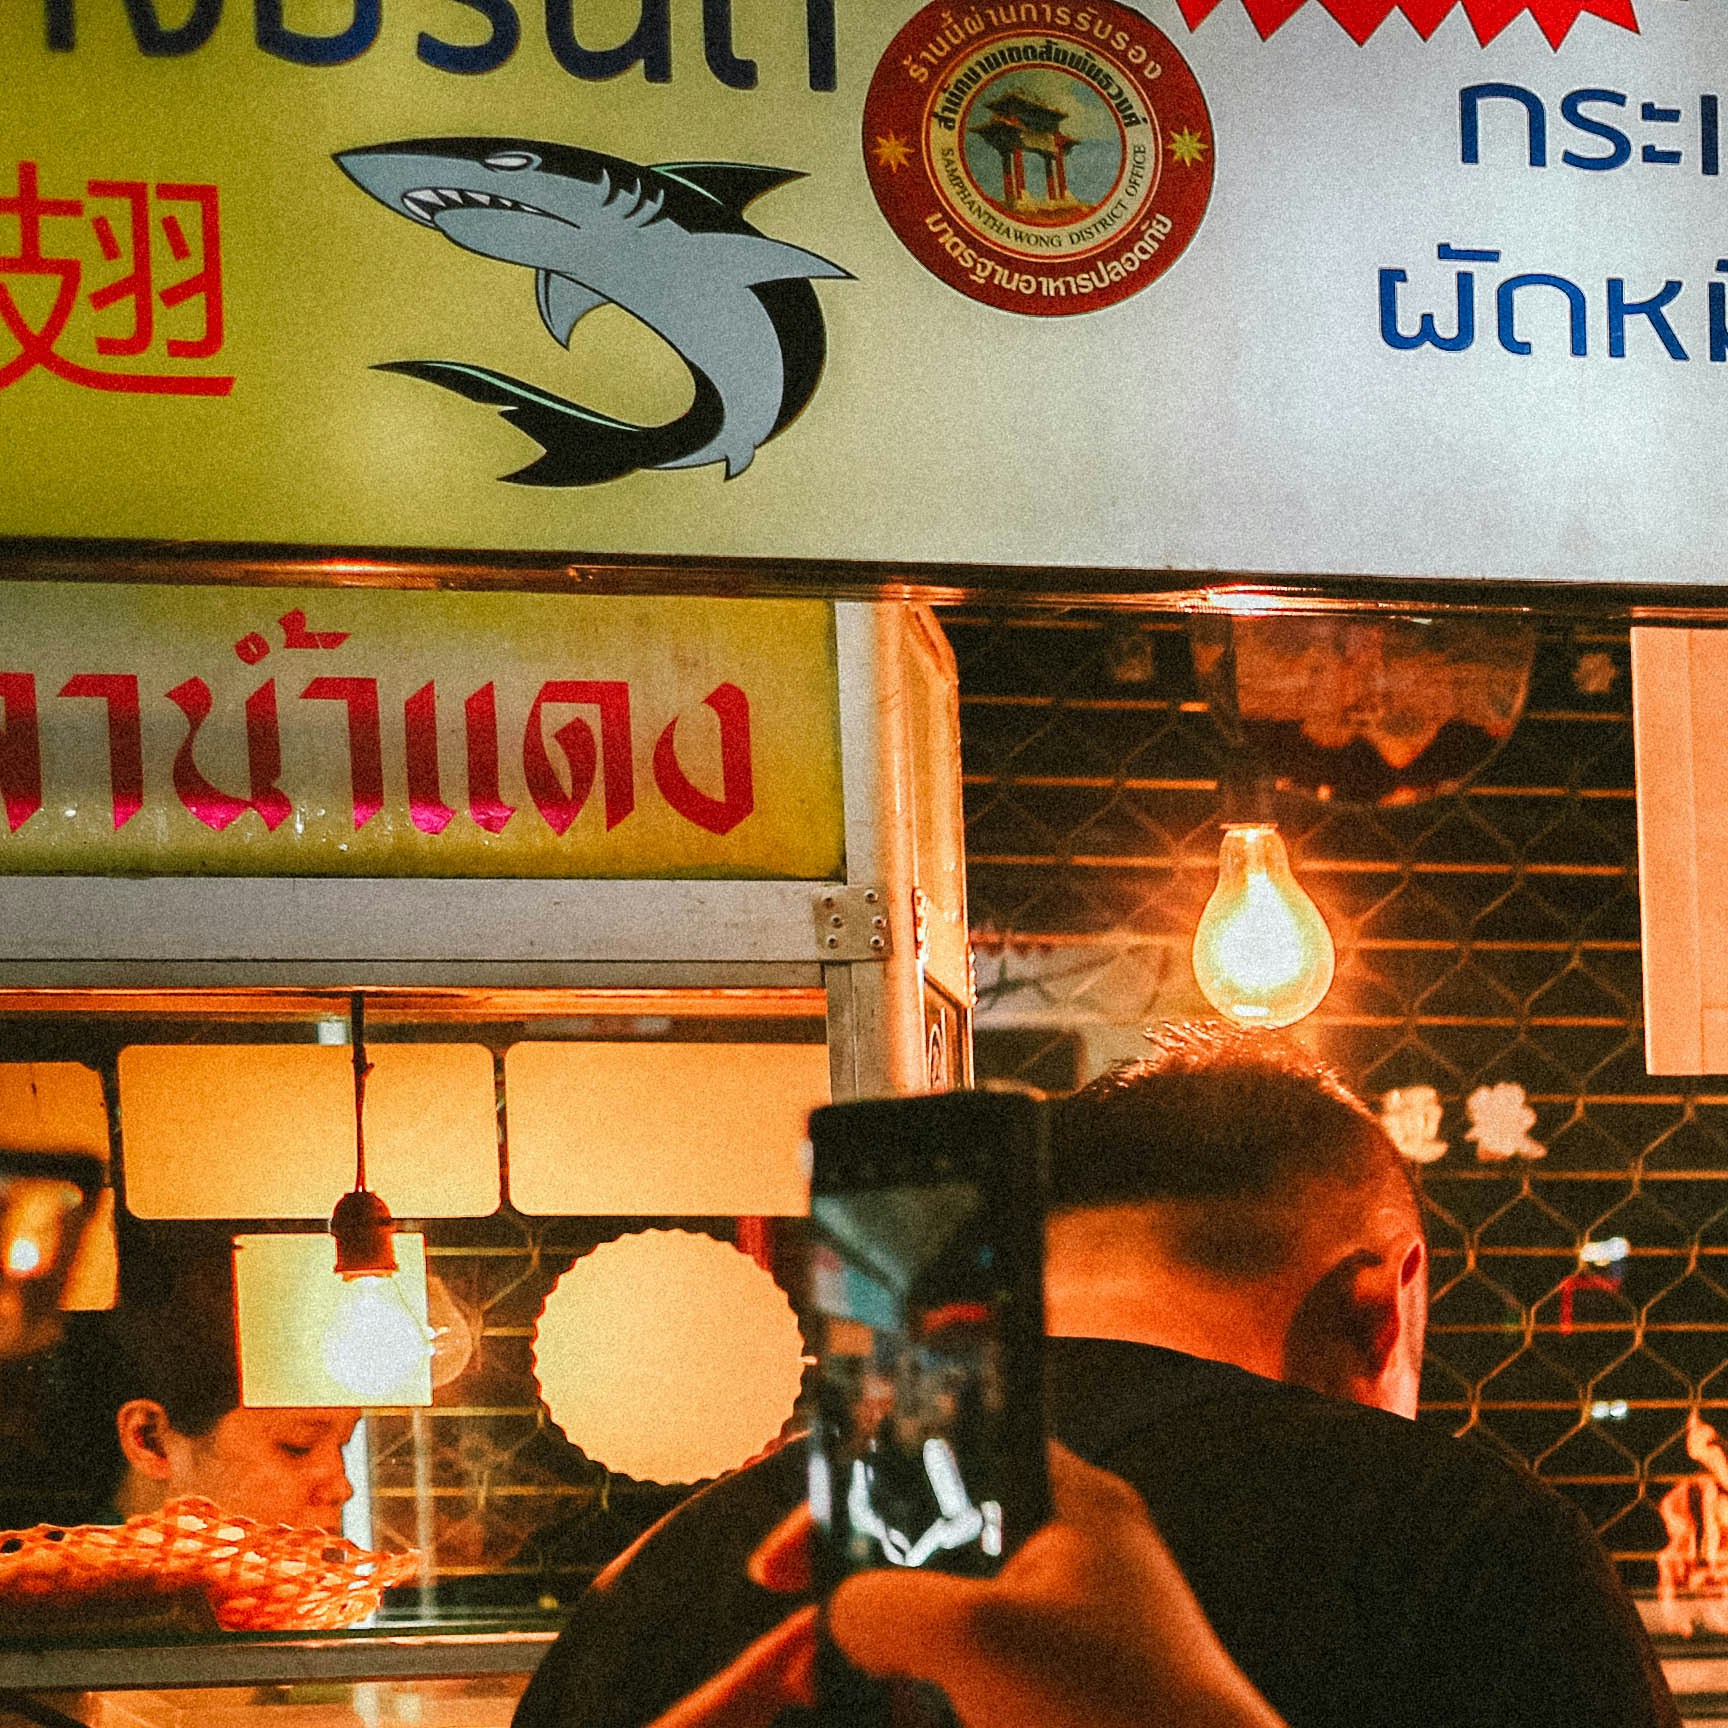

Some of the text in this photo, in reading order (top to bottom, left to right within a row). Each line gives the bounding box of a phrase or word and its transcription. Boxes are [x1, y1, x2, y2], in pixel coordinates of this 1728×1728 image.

[941, 143, 1148, 248] SAMPHANTHAWONG DISTRICT OFFICE
